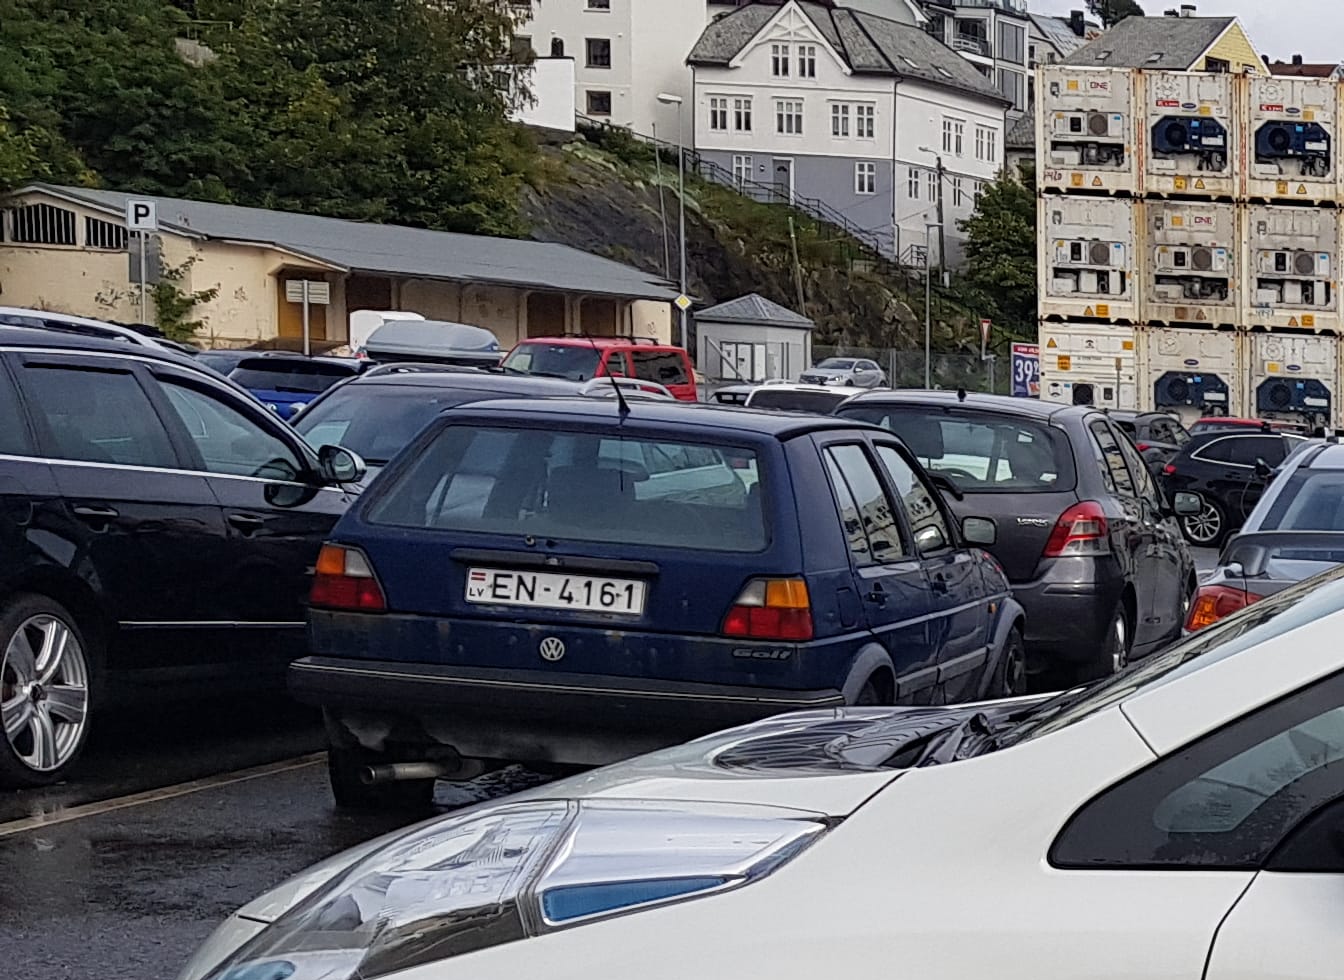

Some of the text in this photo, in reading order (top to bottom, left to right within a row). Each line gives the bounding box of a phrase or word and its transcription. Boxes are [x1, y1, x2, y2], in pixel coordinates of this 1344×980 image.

[1089, 81, 1109, 90] ONE
[134, 203, 150, 225] P
[469, 587, 484, 598] LV
[491, 573, 634, 610] EN-4161
